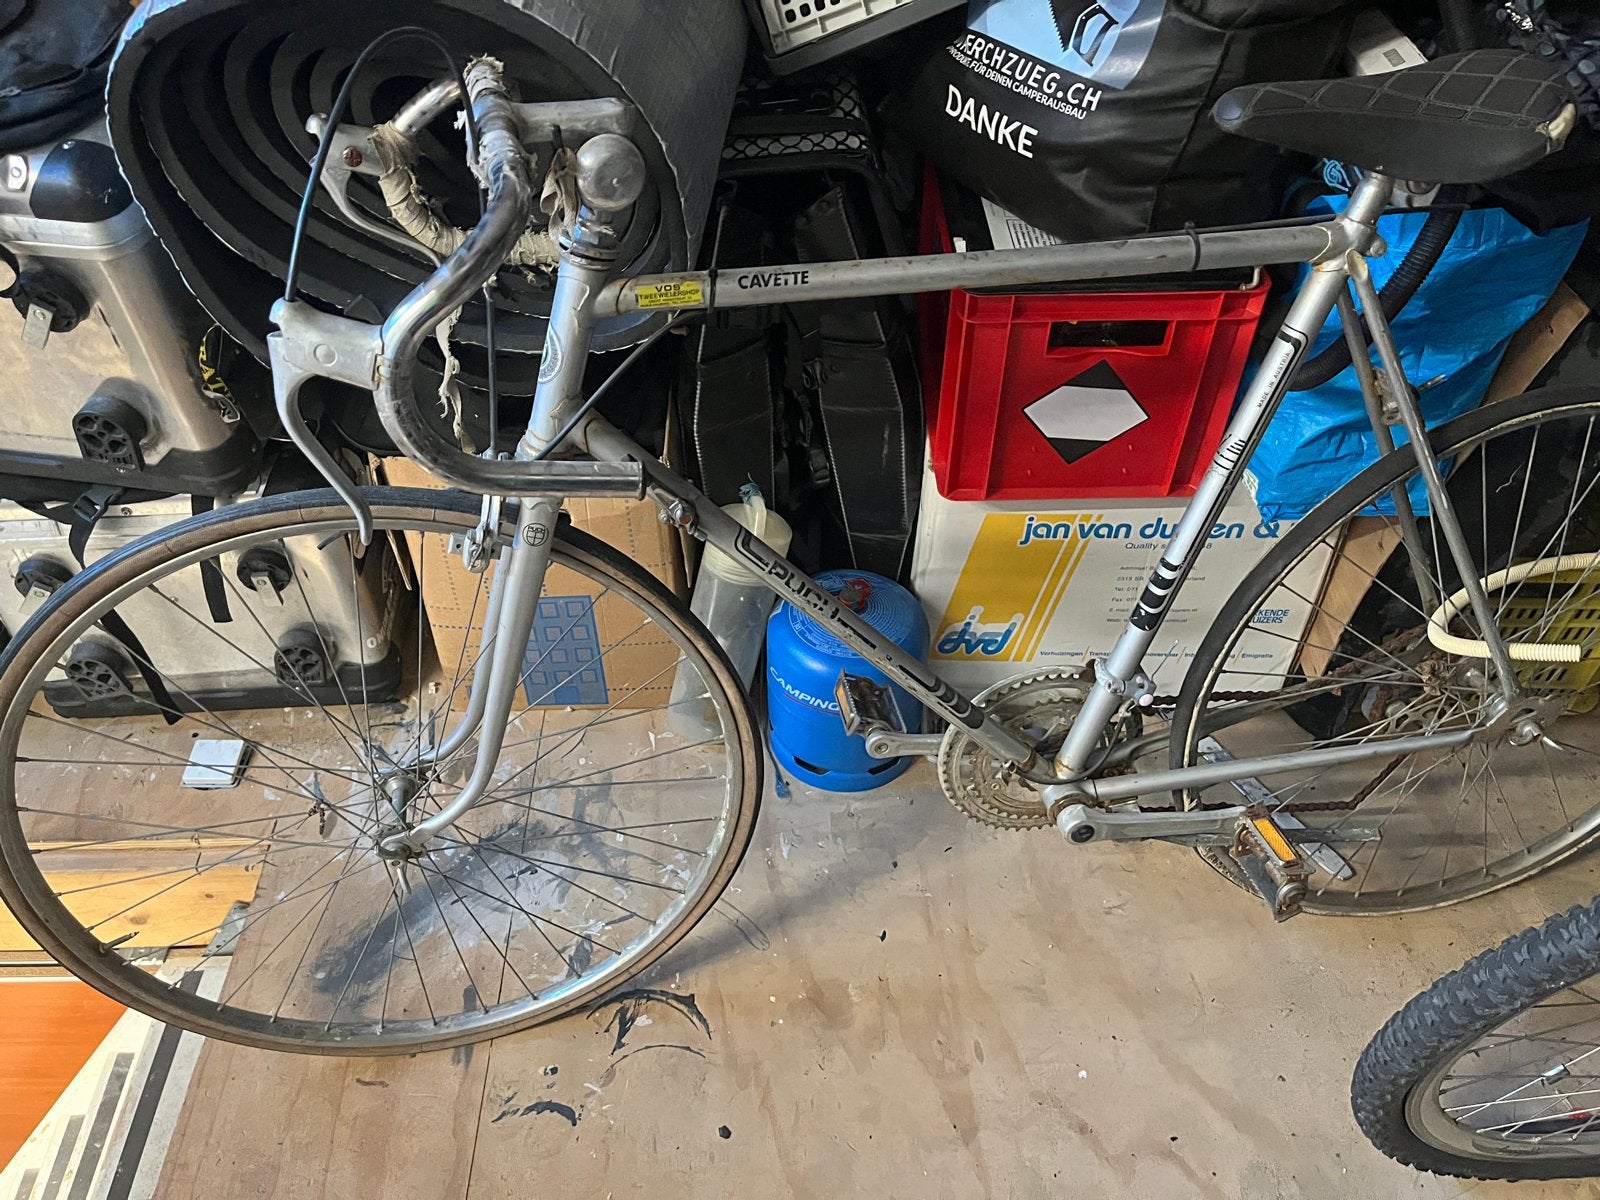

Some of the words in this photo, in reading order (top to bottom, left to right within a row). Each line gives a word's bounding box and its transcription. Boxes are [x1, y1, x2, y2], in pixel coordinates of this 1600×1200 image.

[969, 60, 987, 76] FÜR
[985, 68, 1013, 90] DEINEN
[1012, 81, 1087, 120] CAMPERAUSBAU
[945, 84, 1039, 158] DANKE
[655, 284, 681, 292] VOS
[738, 270, 809, 290] CAVETTE
[1257, 392, 1269, 408] MADE
[1273, 352, 1291, 379] AUSTRIA
[1019, 516, 1071, 545] jan
[1078, 523, 1132, 539] van
[1125, 542, 1159, 550] Quality
[1256, 609, 1290, 617] KENDE
